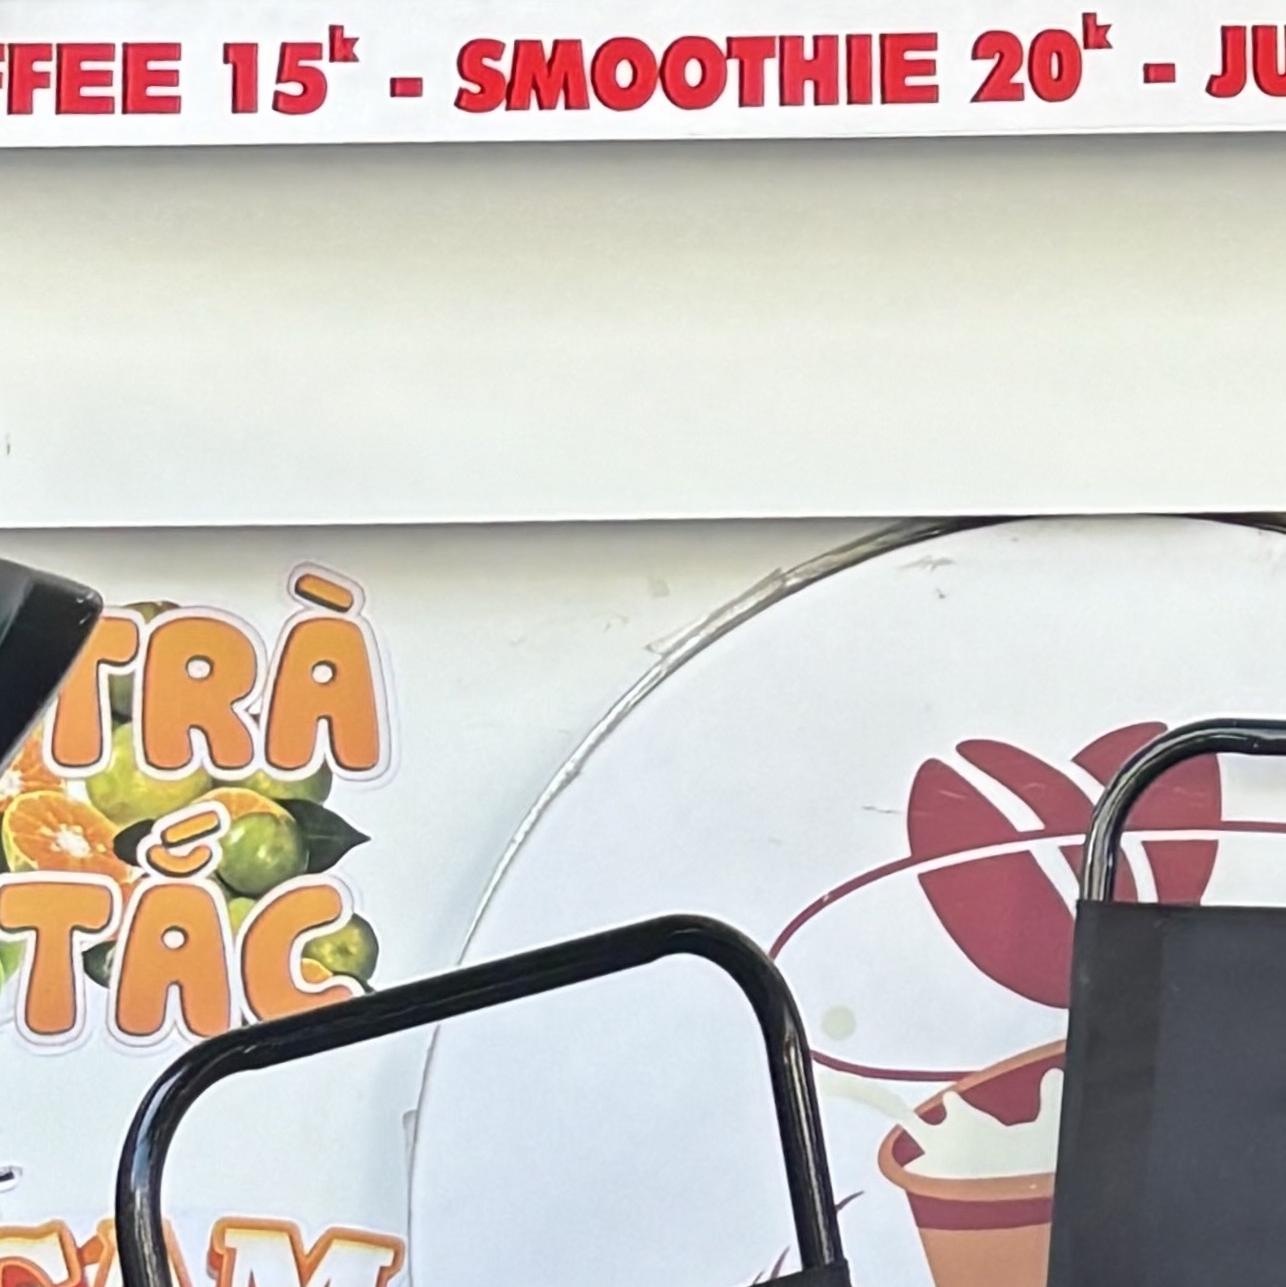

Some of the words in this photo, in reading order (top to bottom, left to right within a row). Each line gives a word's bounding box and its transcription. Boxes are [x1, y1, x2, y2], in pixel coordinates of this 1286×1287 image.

[0, 42, 182, 115] FEE
[453, 31, 940, 114] SMOOTHIE
[48, 571, 384, 773] TRÀ
[0, 807, 358, 1039] TẮC
